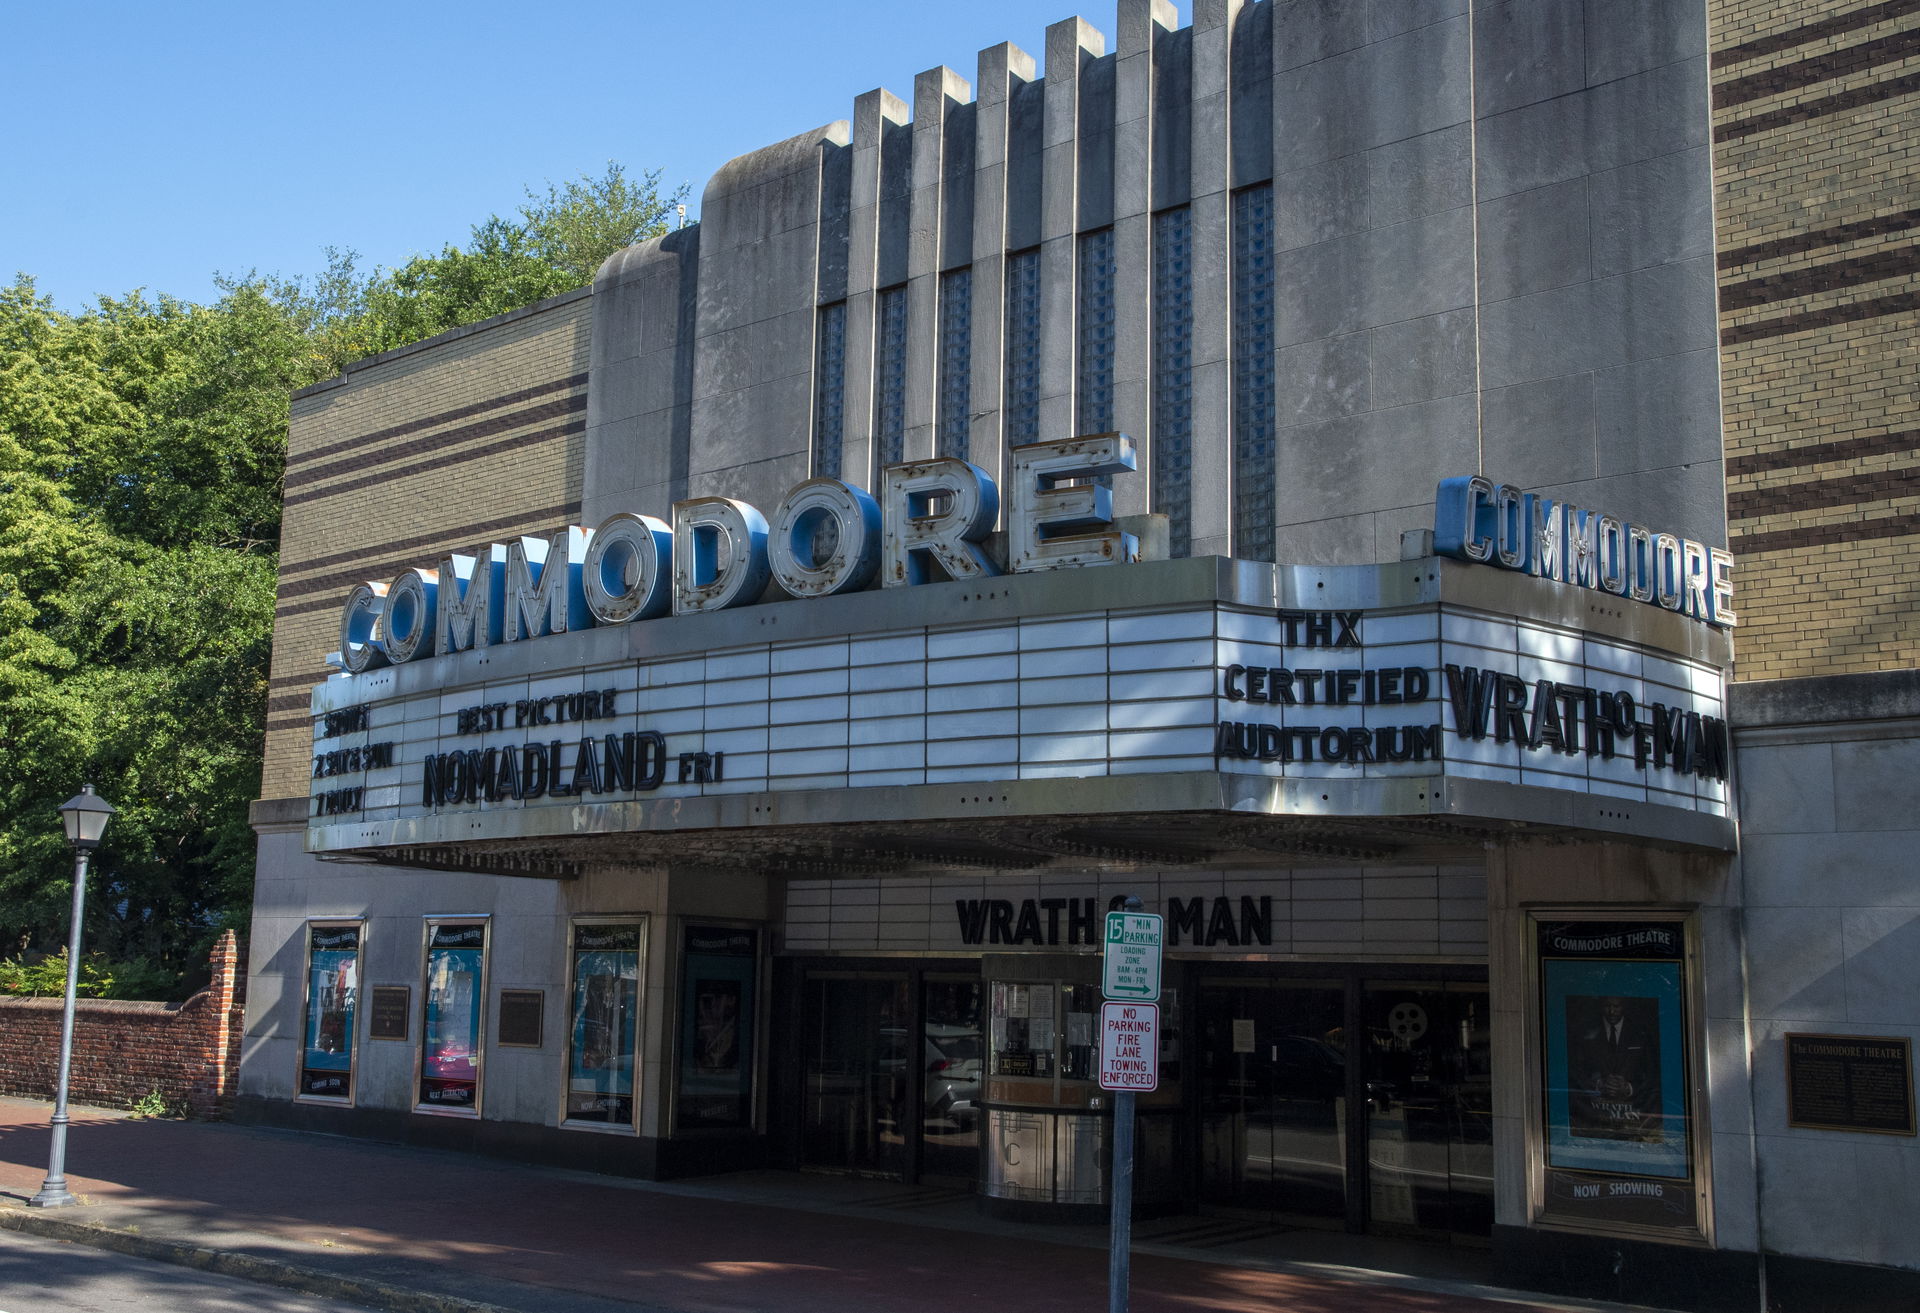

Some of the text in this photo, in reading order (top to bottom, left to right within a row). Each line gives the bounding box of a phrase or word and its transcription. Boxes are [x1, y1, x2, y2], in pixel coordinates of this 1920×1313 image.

[341, 432, 1138, 673] COMMODORE
[1436, 475, 1737, 627] COMMODORE
[1279, 609, 1364, 648] THX
[1224, 663, 1430, 705] CERTIFIED
[456, 687, 617, 736] BEST PICTURE
[1445, 663, 1615, 760] WRATH
[1652, 702, 1728, 784] MAN
[1216, 721, 1442, 763] AUDITORIUM
[422, 730, 724, 808] NOMADLAND FRI
[956, 895, 1273, 946] WRATH MAN
[1136, 919, 1151, 930] MIN
[1108, 919, 1123, 940] 15
[436, 932, 463, 944] COMMODORE
[1124, 931, 1159, 944] PARKING
[1554, 930, 1671, 951] COMMODORE THEATRE
[1120, 946, 1146, 955] LOADING
[1125, 957, 1140, 965] ZONE
[1134, 967, 1148, 975] 4PM
[1118, 975, 1132, 984] MON
[1135, 976, 1146, 985] FRI
[1122, 1008, 1137, 1020] NO
[1108, 1020, 1151, 1033] PARKING
[1118, 1034, 1141, 1046] FIRE
[1115, 1046, 1142, 1059] LANE
[1808, 1044, 1861, 1057] COMMODORE
[1863, 1046, 1904, 1059] THEATRE
[1110, 1060, 1148, 1072] TOWING
[1103, 1072, 1154, 1085] ENFORCED
[1574, 1182, 1663, 1198] NOW SHOWING
